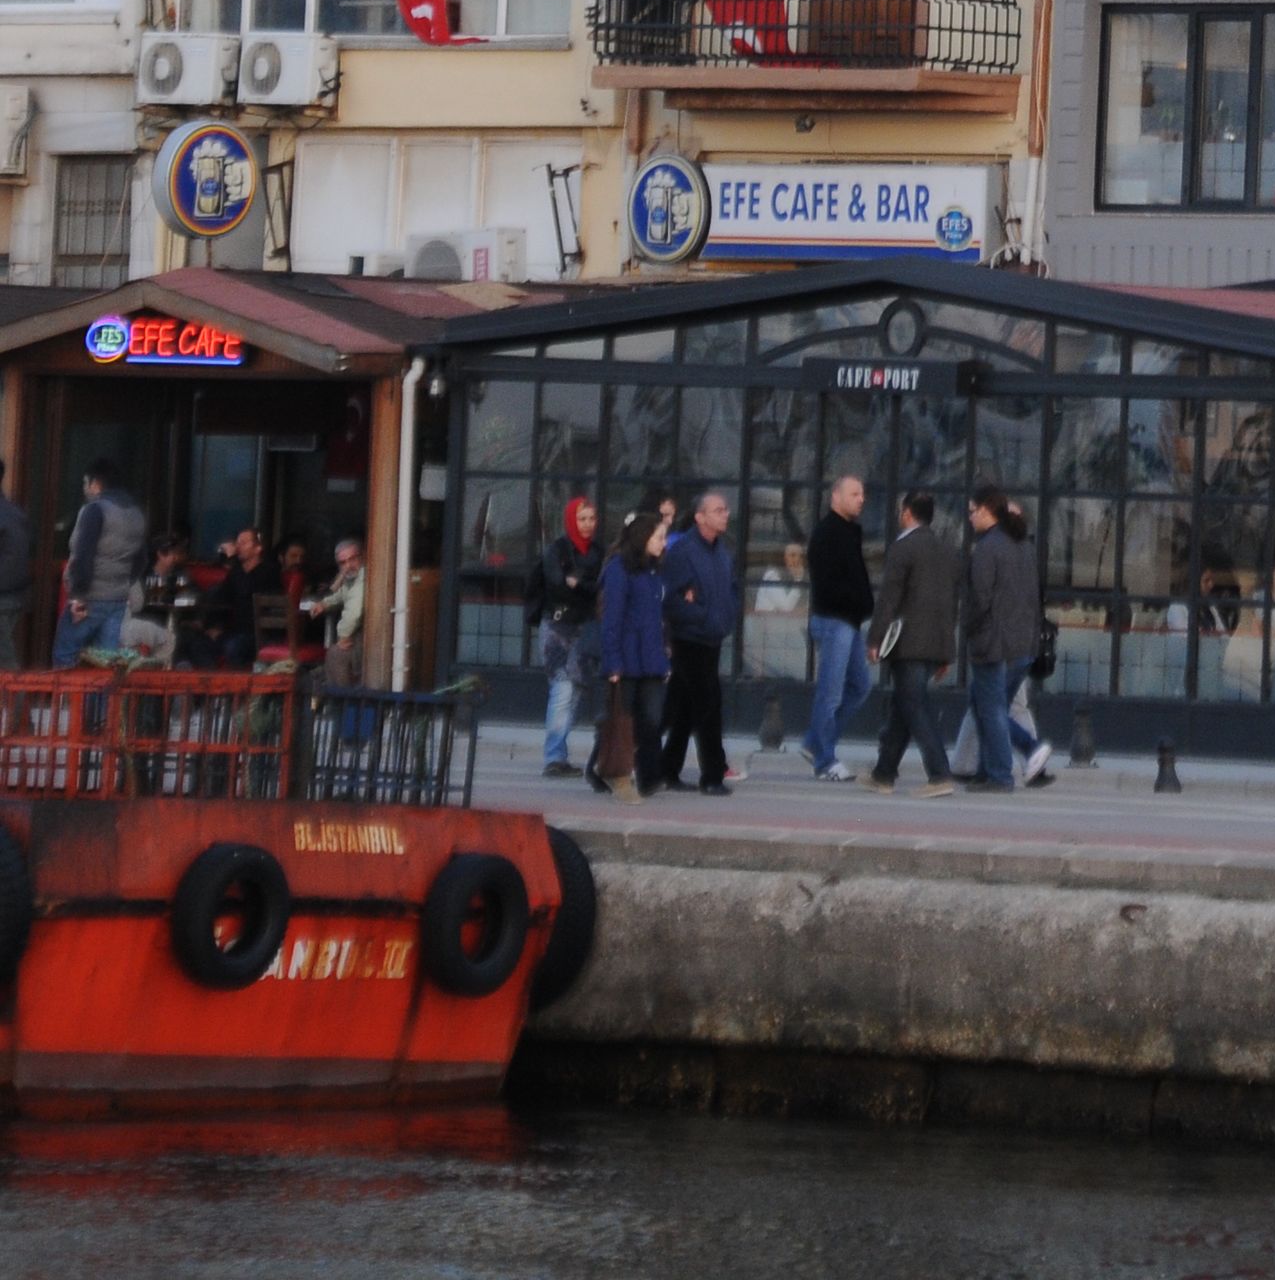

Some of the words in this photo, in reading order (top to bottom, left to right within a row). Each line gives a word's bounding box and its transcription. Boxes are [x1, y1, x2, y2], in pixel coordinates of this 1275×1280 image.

[719, 182, 761, 220] EFE
[771, 182, 839, 221] CAFE
[848, 183, 866, 223] &
[876, 184, 931, 224] BAR
[941, 217, 969, 232] EFES
[128, 323, 176, 357] EFE
[178, 324, 242, 359] CAFE
[837, 366, 872, 389] CAFE
[883, 367, 920, 391] PORT
[257, 936, 373, 981] ANBUL
